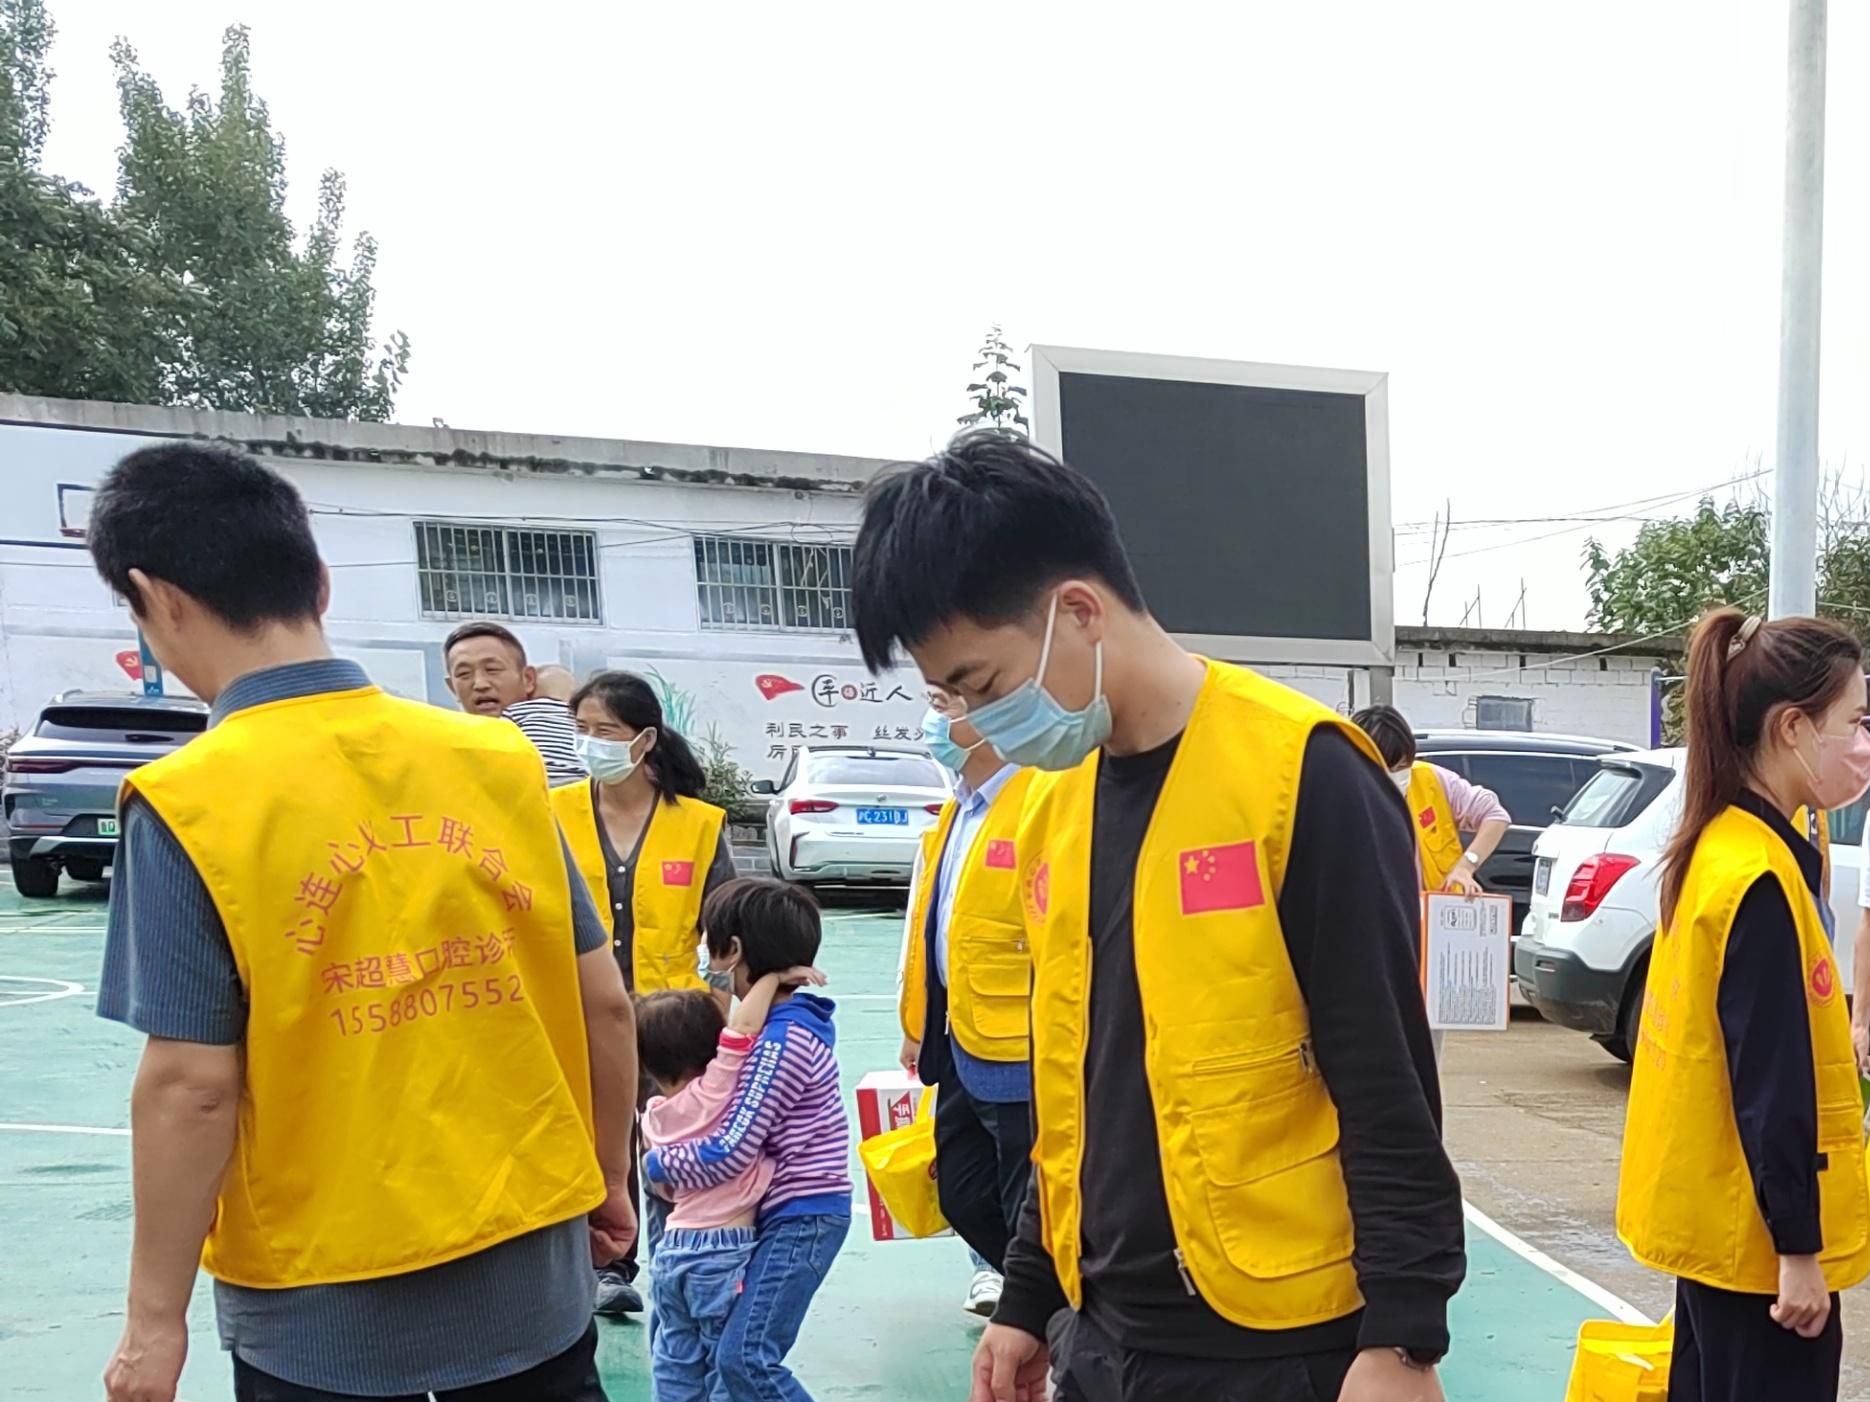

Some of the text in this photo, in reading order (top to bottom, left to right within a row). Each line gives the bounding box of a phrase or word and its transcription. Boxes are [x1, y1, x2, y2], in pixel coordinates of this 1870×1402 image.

[284, 814, 534, 957] 心连心义工联合会
